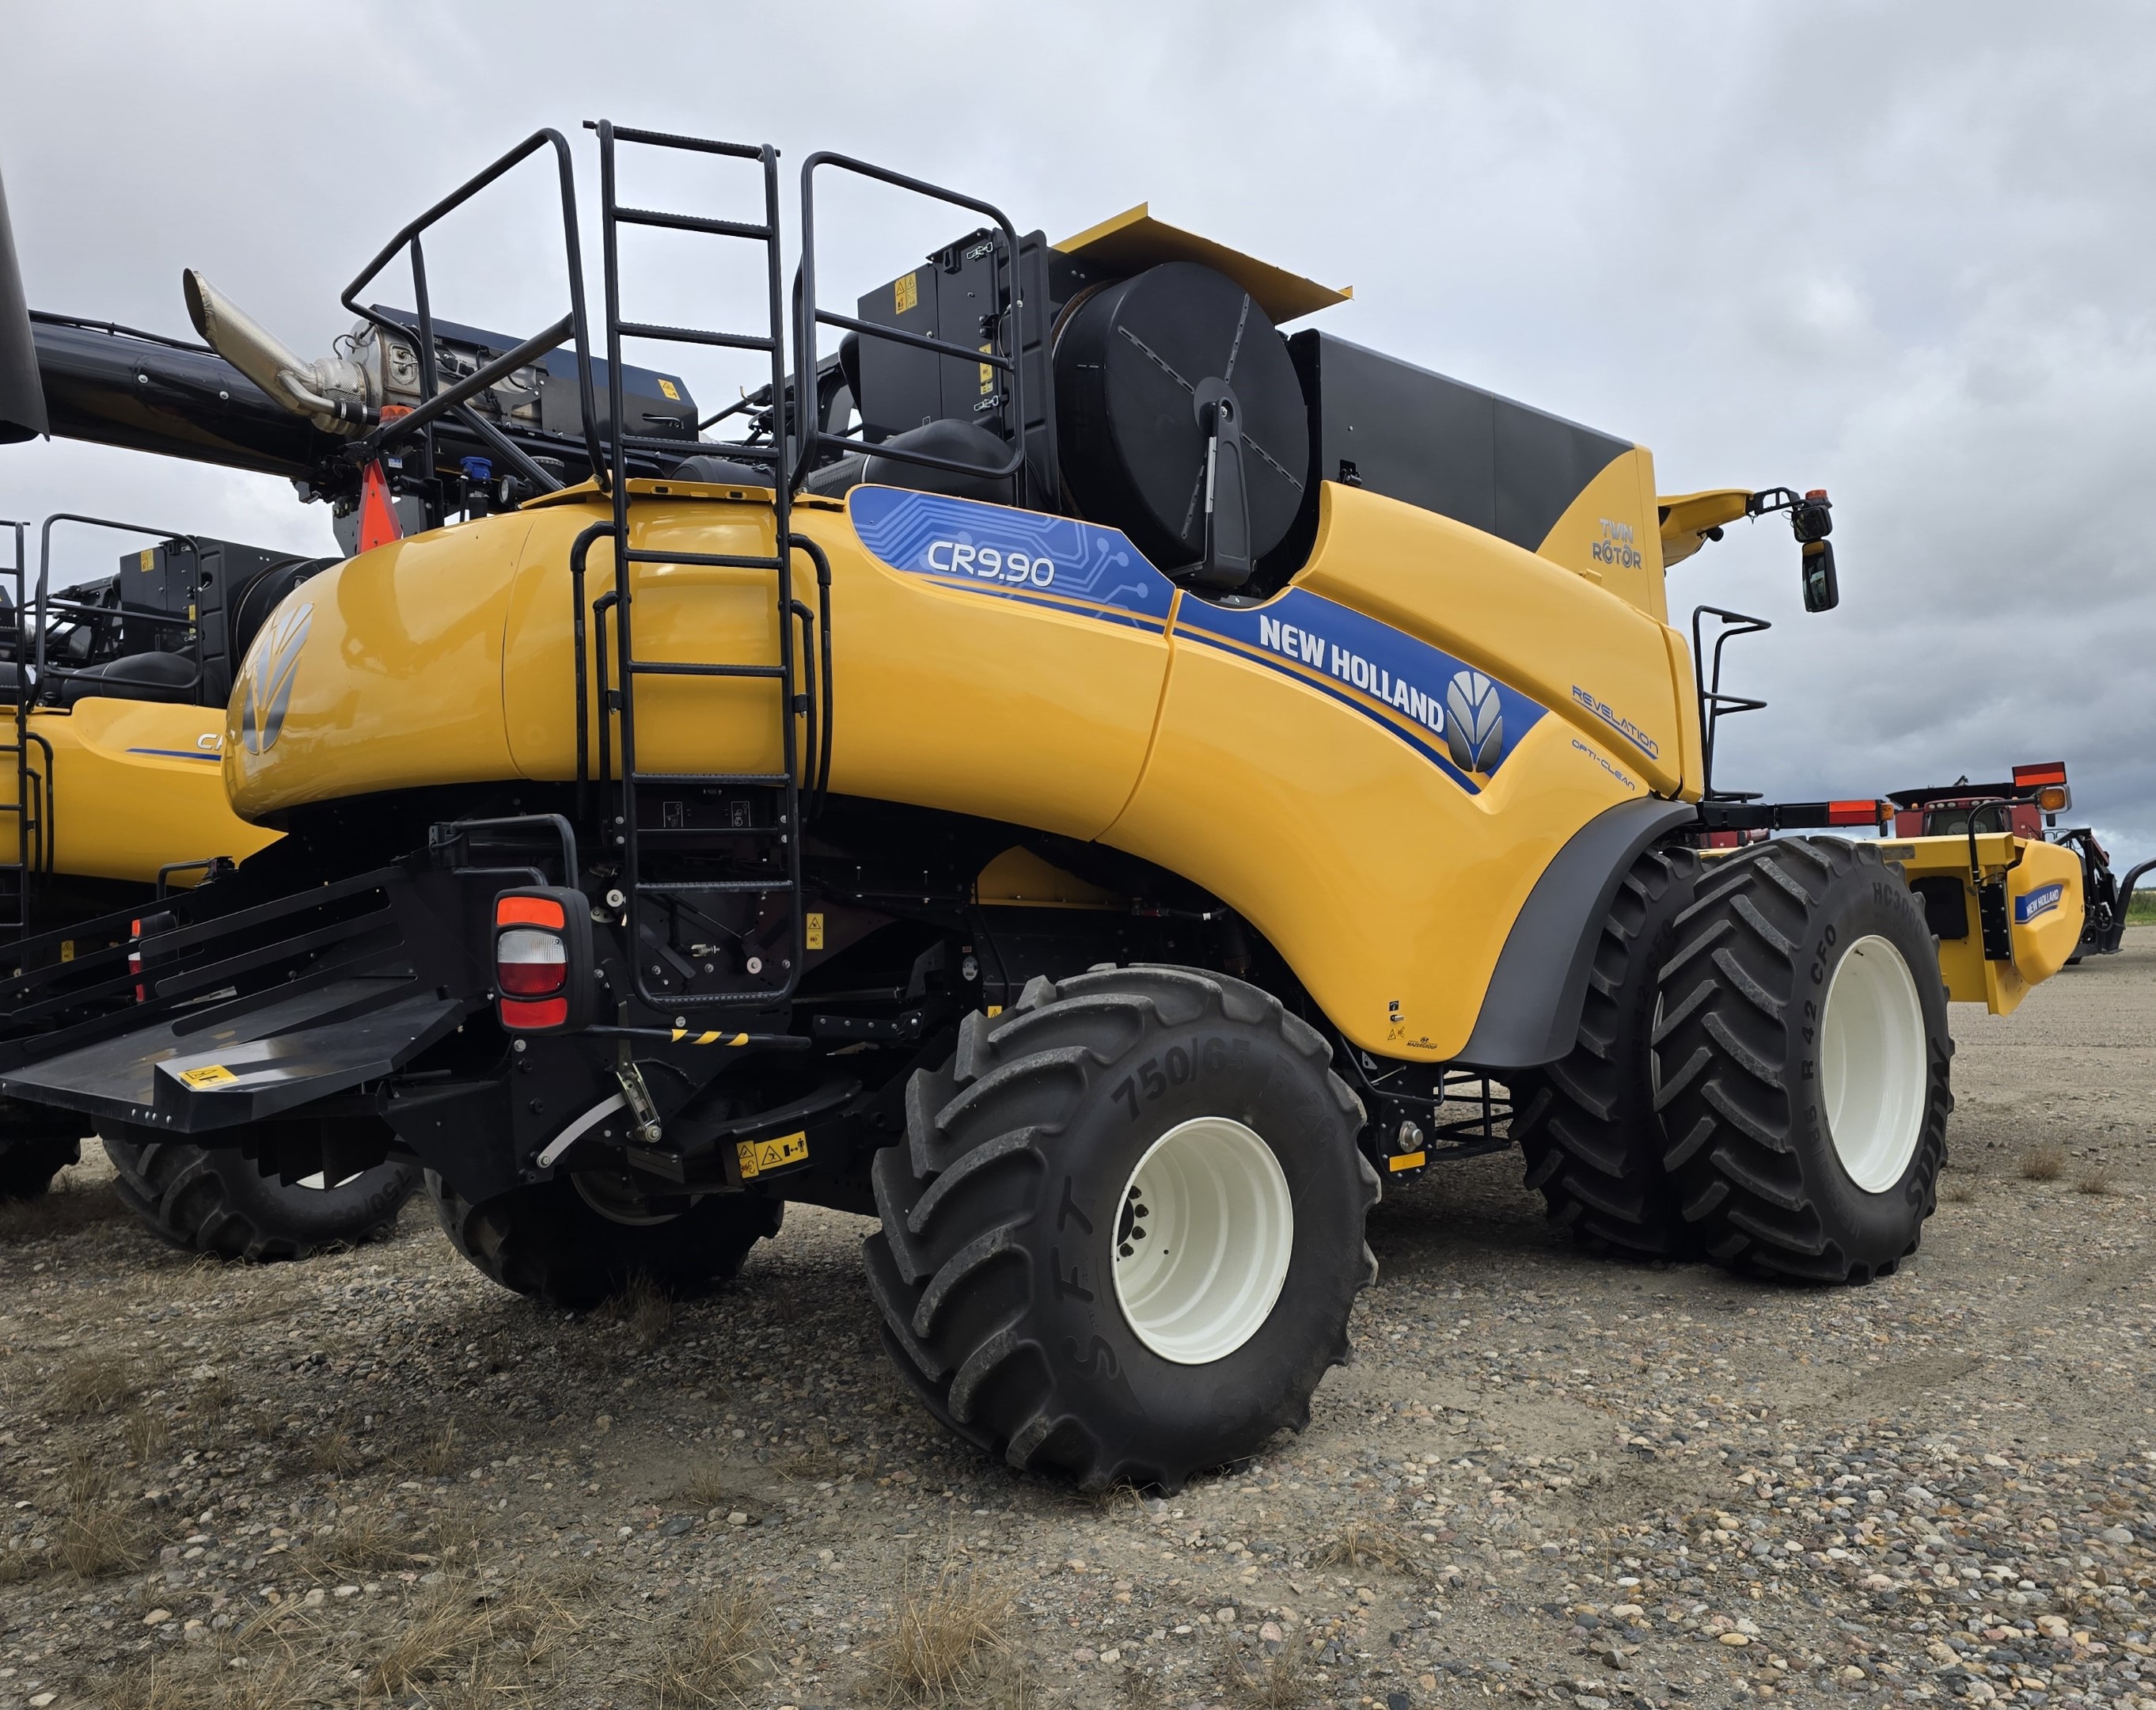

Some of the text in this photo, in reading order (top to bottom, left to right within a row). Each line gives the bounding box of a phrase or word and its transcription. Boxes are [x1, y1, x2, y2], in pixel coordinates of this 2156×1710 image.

[1592, 539, 1642, 570] ROTOR
[1599, 518, 1633, 544] TWIN
[928, 541, 1054, 587] CR9.90
[1260, 614, 1444, 733] NEW HOLLAND
[1572, 684, 1659, 755] REVELATION
[1572, 739, 1635, 792] OPTI-CLEAN
[2026, 889, 2059, 917] NEW HOLLAND
[1810, 923, 1837, 986] CFO
[1110, 1037, 1251, 1123] 750/65
